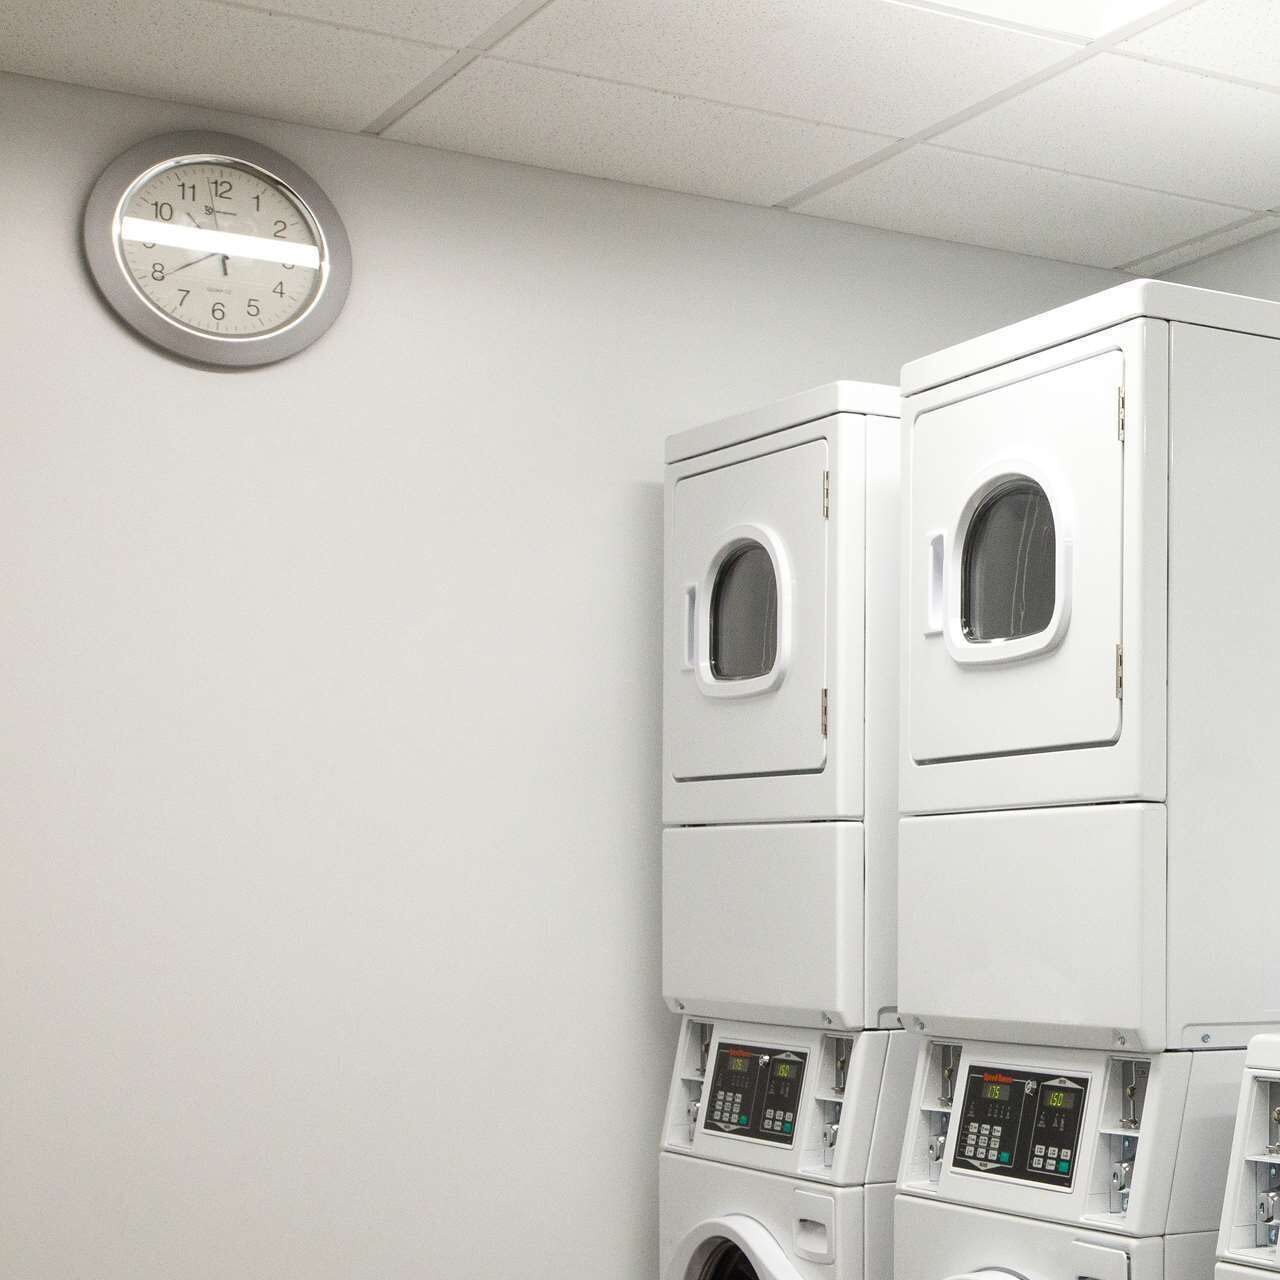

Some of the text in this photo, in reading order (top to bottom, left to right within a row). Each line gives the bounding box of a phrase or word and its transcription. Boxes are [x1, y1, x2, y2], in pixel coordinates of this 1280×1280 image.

[177, 182, 195, 201] 11
[210, 179, 233, 200] 12
[151, 201, 174, 221] 10
[252, 194, 260, 212] 1
[273, 220, 288, 238] 2
[151, 263, 165, 281] 8
[178, 288, 191, 306] 7
[272, 281, 285, 298] 4
[211, 302, 225, 320] 6
[246, 298, 260, 316] 5
